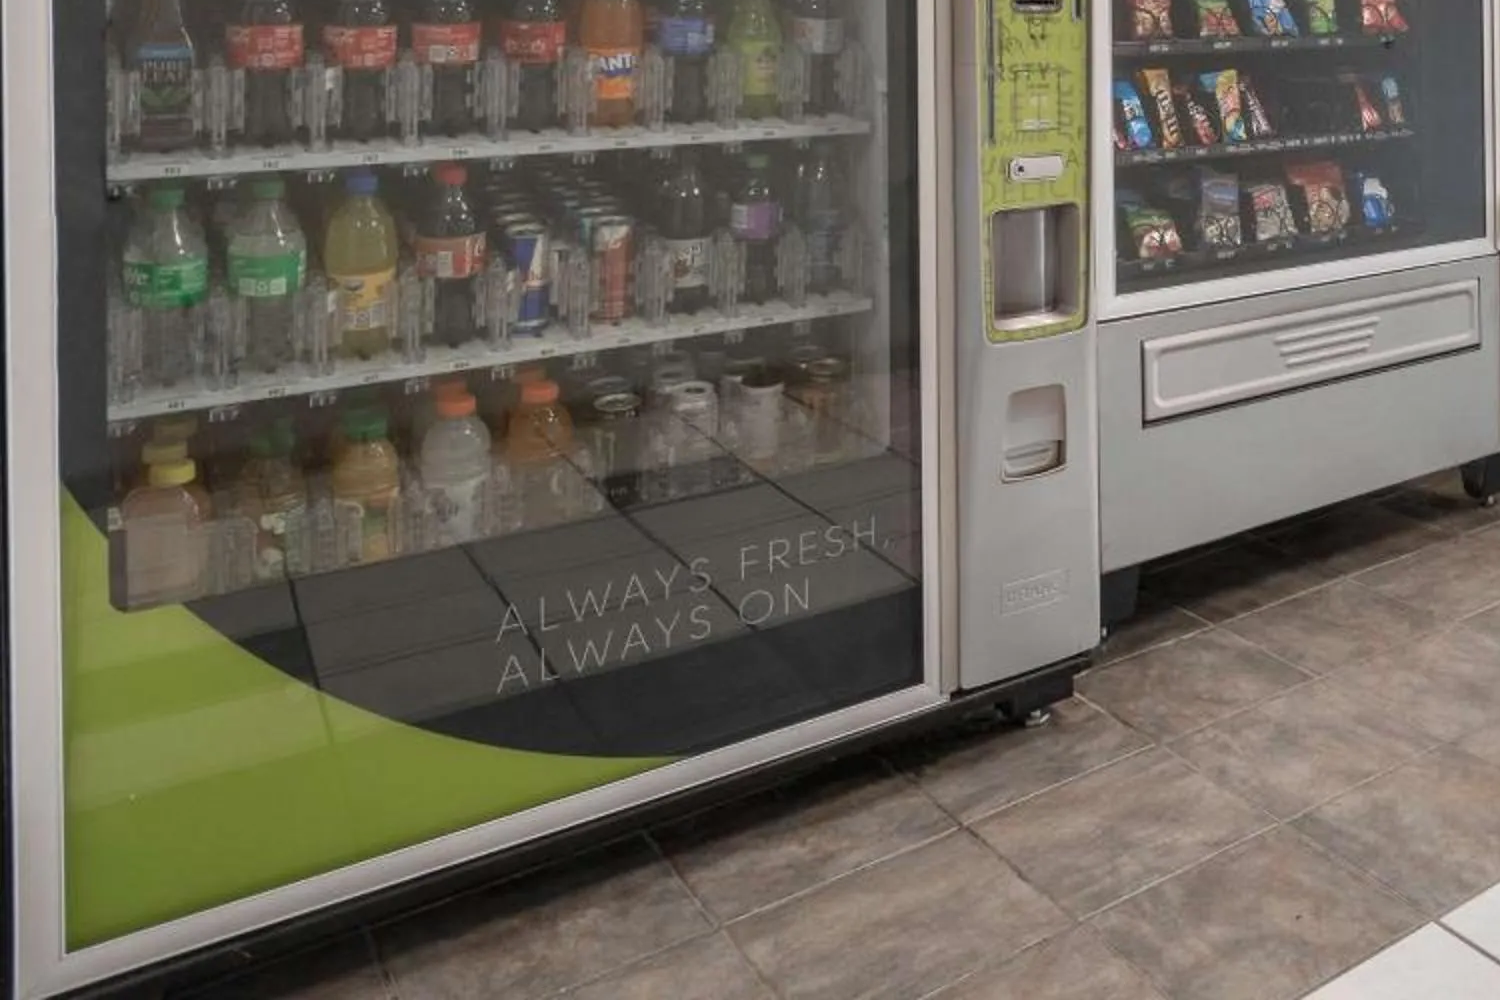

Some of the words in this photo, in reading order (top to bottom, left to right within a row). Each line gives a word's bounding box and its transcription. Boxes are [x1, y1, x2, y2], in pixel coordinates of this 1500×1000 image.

[496, 556, 712, 644] ALWAYS
[496, 604, 712, 695] ALWAYS
[738, 577, 810, 626] ON
